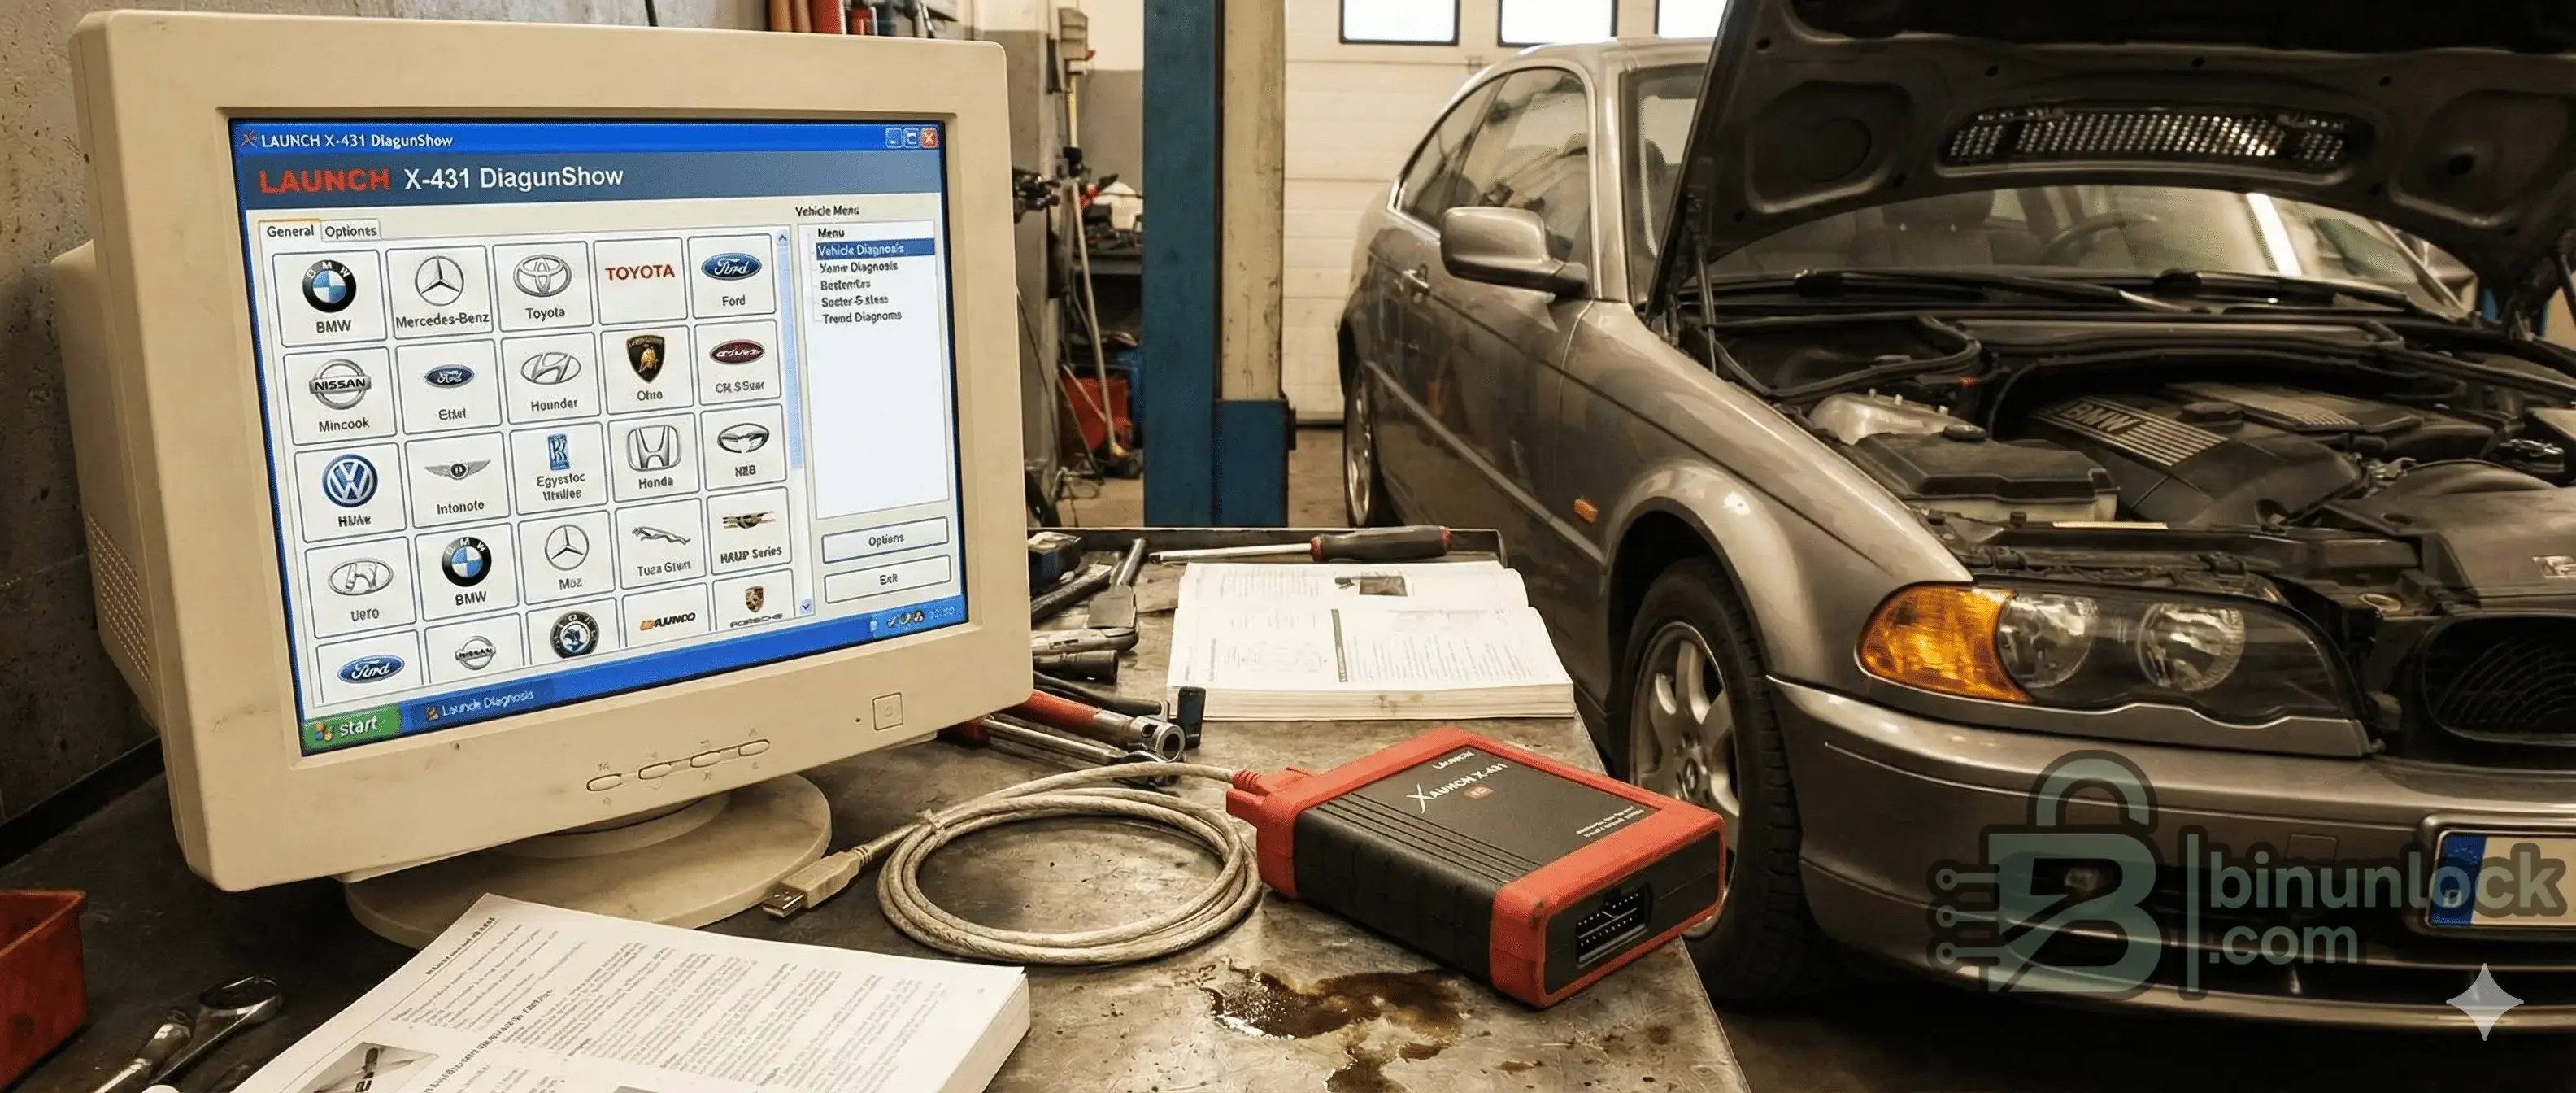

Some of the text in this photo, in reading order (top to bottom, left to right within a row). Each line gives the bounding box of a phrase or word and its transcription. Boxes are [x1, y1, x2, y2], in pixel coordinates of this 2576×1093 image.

[261, 133, 320, 148] LAUNCH
[371, 133, 454, 150] DiagunShow
[259, 165, 624, 194] LAUNCH X-431 DiagunShow
[266, 224, 315, 238] General
[817, 228, 845, 239] Menu
[818, 245, 855, 257] Vehicle
[605, 264, 676, 281] TOYOTA
[722, 294, 746, 308] Ford
[395, 314, 491, 330] Mercedes-Benz
[525, 306, 567, 323] Toyota
[316, 320, 352, 334] BMW
[314, 377, 367, 391] NISSAN
[318, 417, 371, 433] Mincook
[2060, 403, 2142, 433] BMW
[638, 477, 674, 490] Honda
[751, 546, 783, 560] Series
[455, 590, 488, 606] BMW
[339, 716, 378, 736] start
